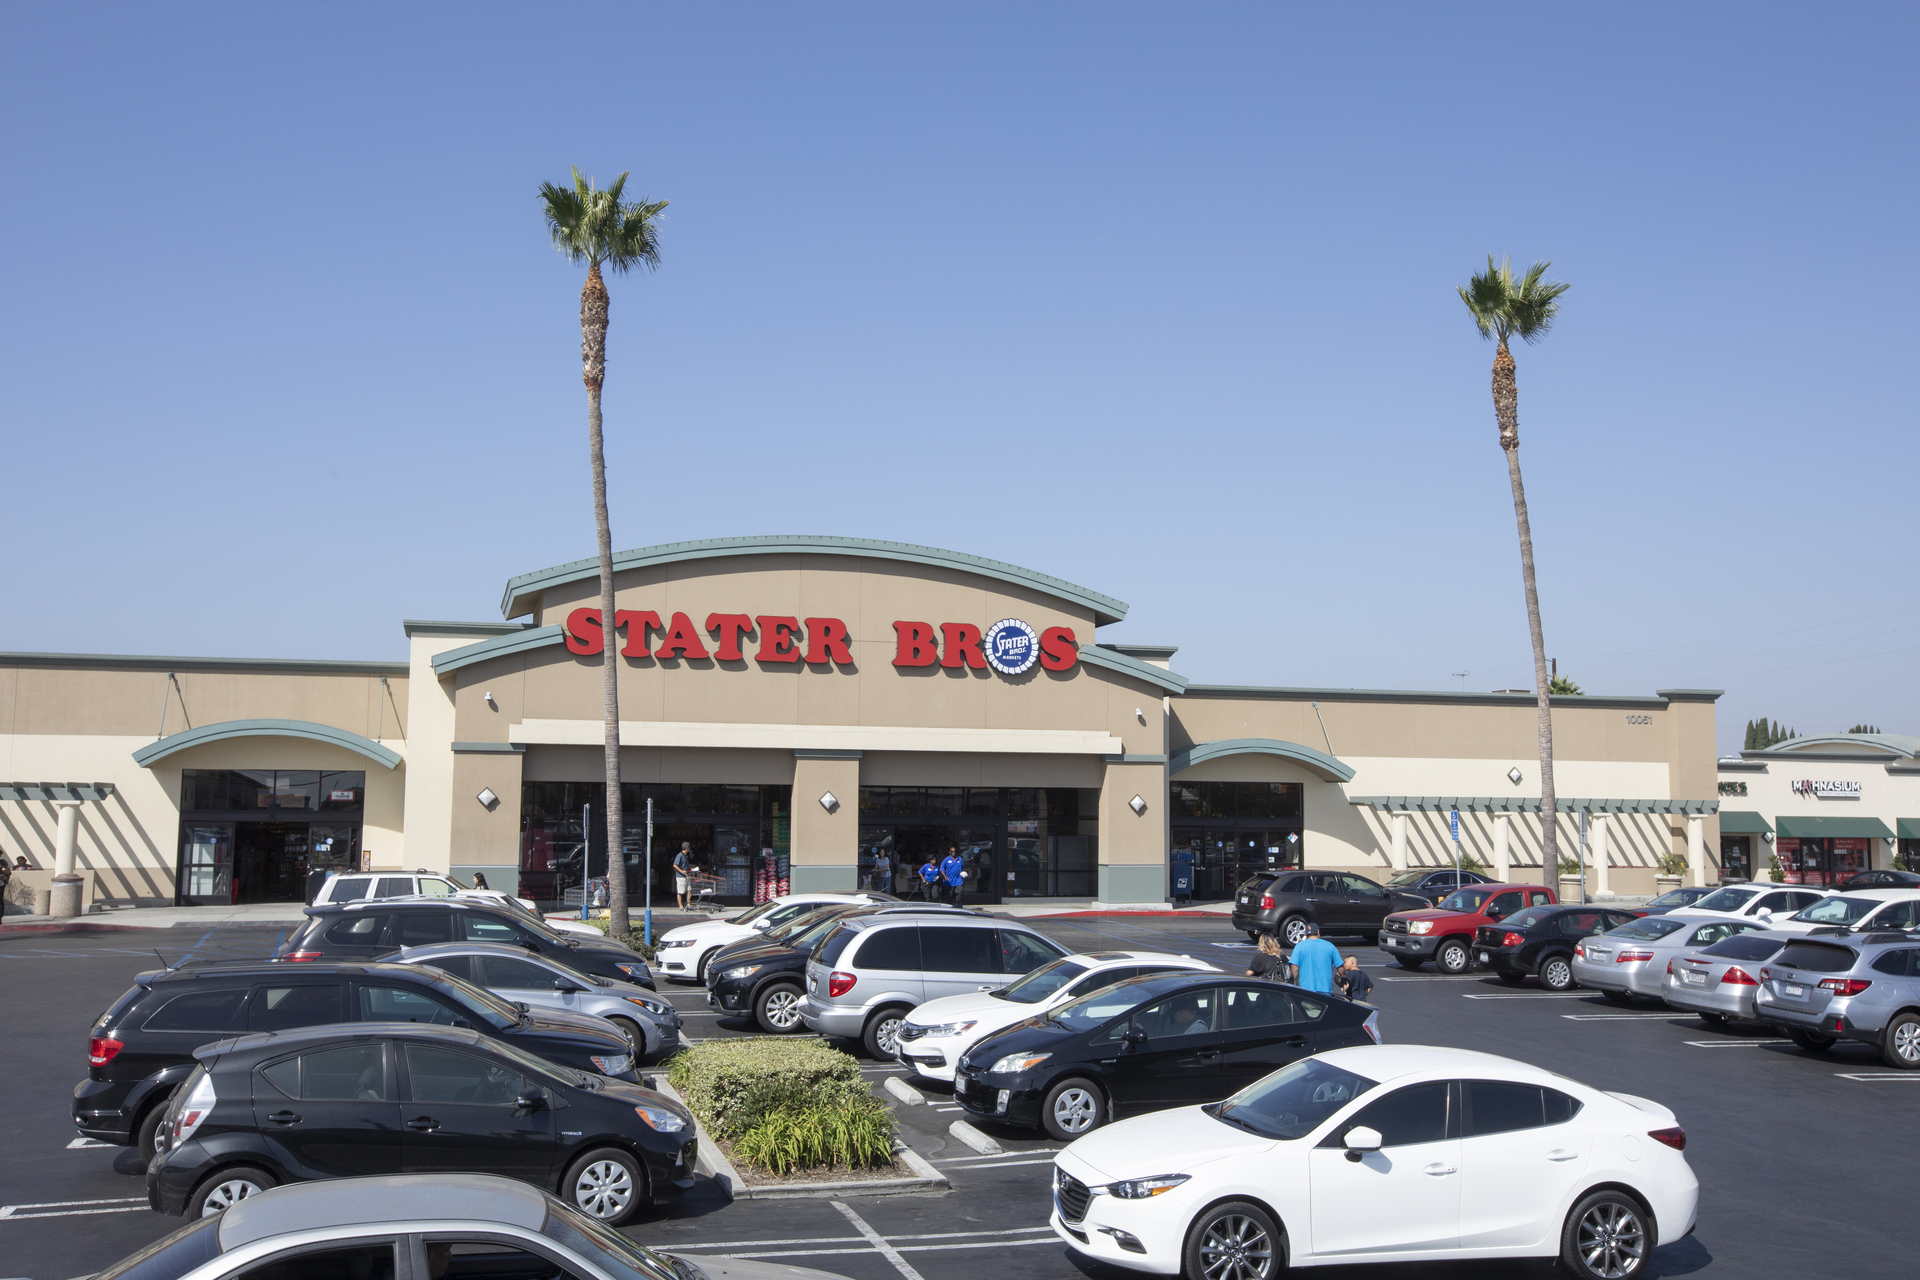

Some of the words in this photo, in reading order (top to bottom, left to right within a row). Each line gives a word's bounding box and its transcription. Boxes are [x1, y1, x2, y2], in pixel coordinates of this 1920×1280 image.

[566, 606, 854, 666] STATER
[995, 632, 1029, 656] STATER
[1626, 714, 1653, 725] 10051
[1793, 780, 1860, 795] MATHNASIUM
